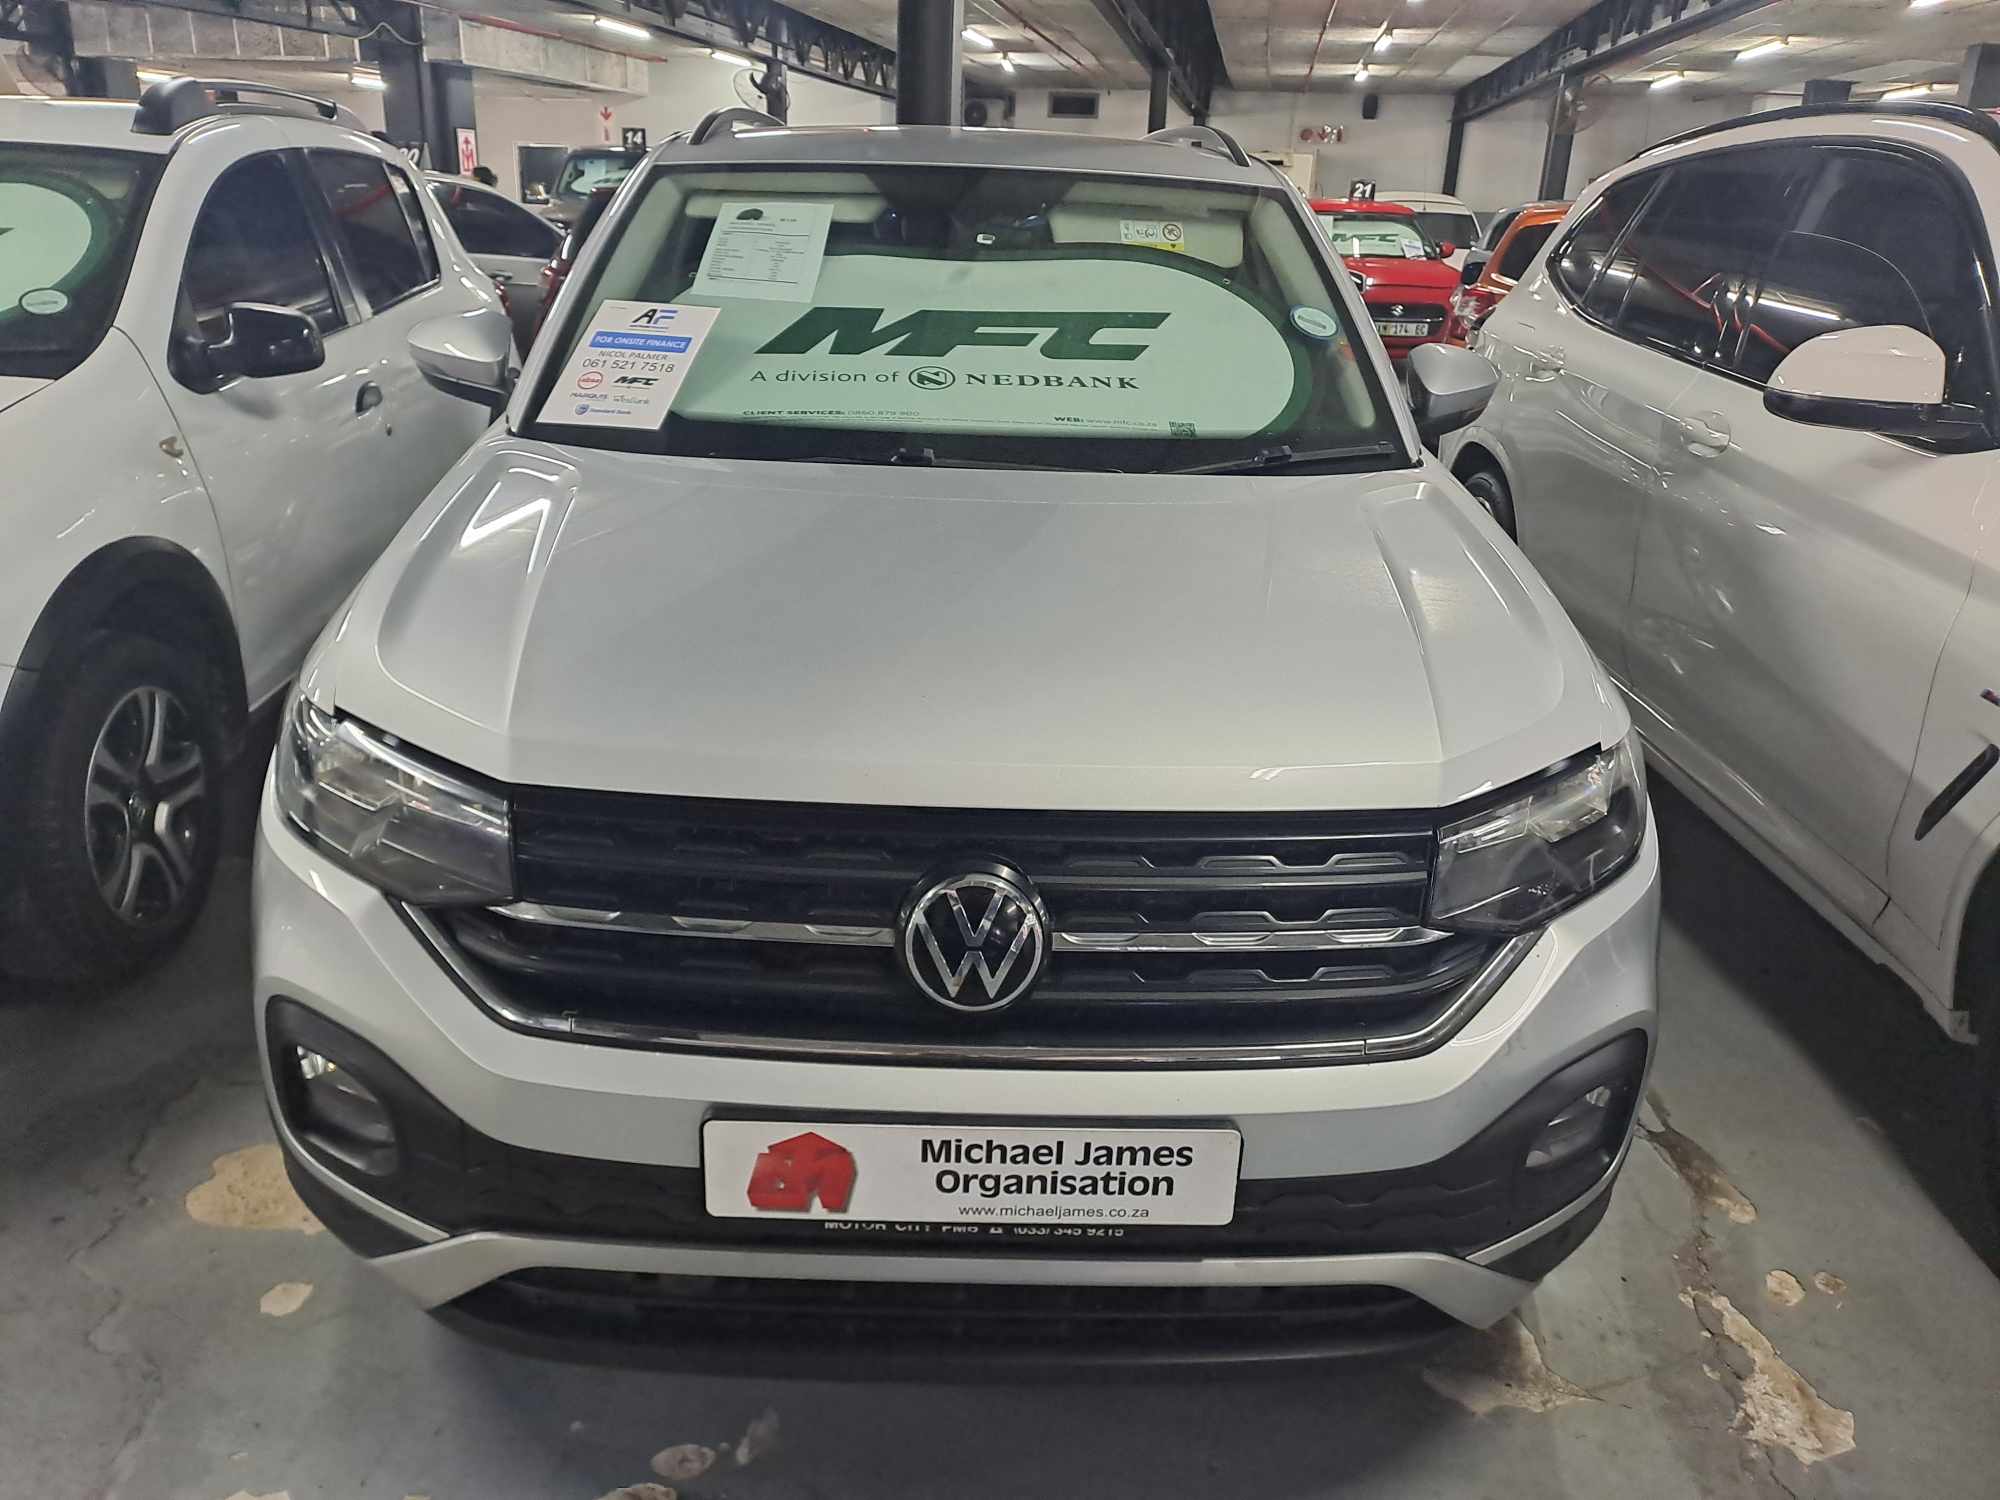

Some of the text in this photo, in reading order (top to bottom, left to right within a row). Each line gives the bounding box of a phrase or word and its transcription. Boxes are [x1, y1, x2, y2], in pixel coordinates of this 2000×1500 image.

[625, 129, 642, 144] 14
[1353, 183, 1373, 198] 21
[754, 306, 1172, 361] MFC
[594, 335, 688, 349] FOR ONSITE FINANCE
[598, 350, 668, 360] NICOL PALMER
[582, 358, 675, 373] 061 521 7518
[612, 376, 659, 387] MFC
[750, 371, 766, 382] A
[775, 370, 867, 382] division
[875, 371, 900, 382] of
[964, 373, 1139, 390] NEDBANK
[920, 1138, 1194, 1167] Michael James
[935, 1169, 1175, 1199] Organisation
[958, 1204, 1150, 1220] www.michaeljames.co.za
